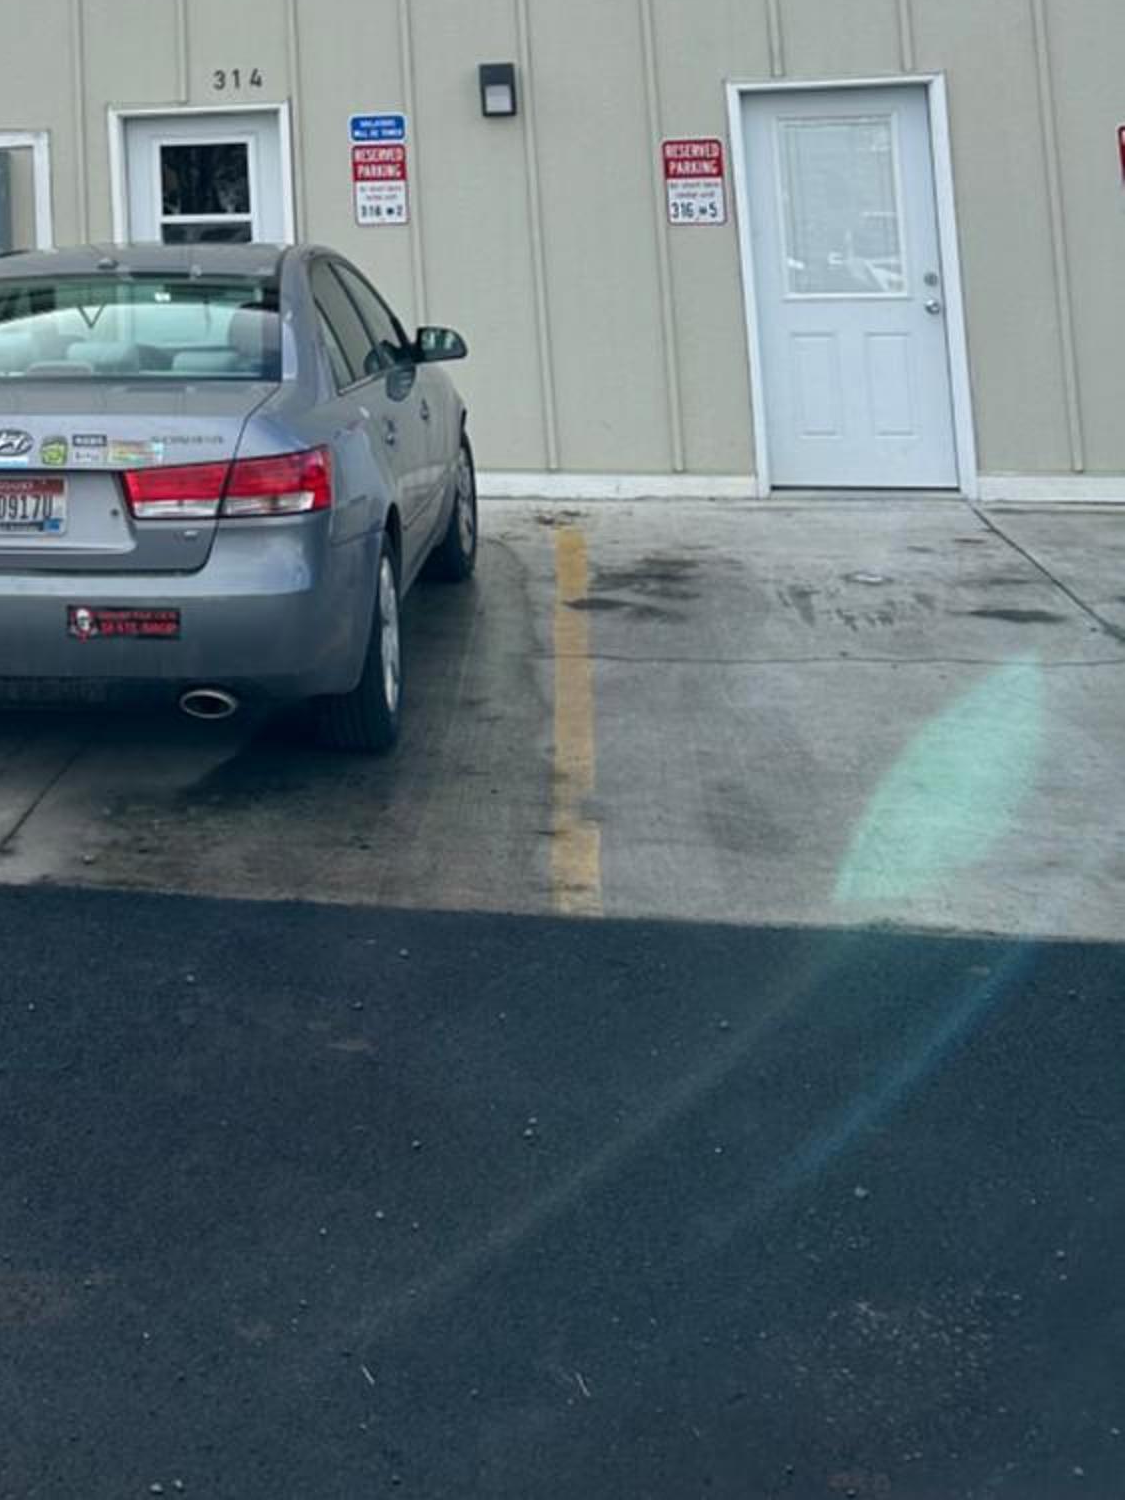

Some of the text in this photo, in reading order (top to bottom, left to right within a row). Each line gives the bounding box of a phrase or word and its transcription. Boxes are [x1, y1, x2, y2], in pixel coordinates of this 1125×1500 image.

[213, 68, 263, 90] 314
[355, 147, 404, 162] RESERVED
[663, 142, 720, 158] RESERVED
[356, 162, 402, 179] PARKING
[668, 159, 718, 175] PARKING
[671, 202, 694, 219] 316
